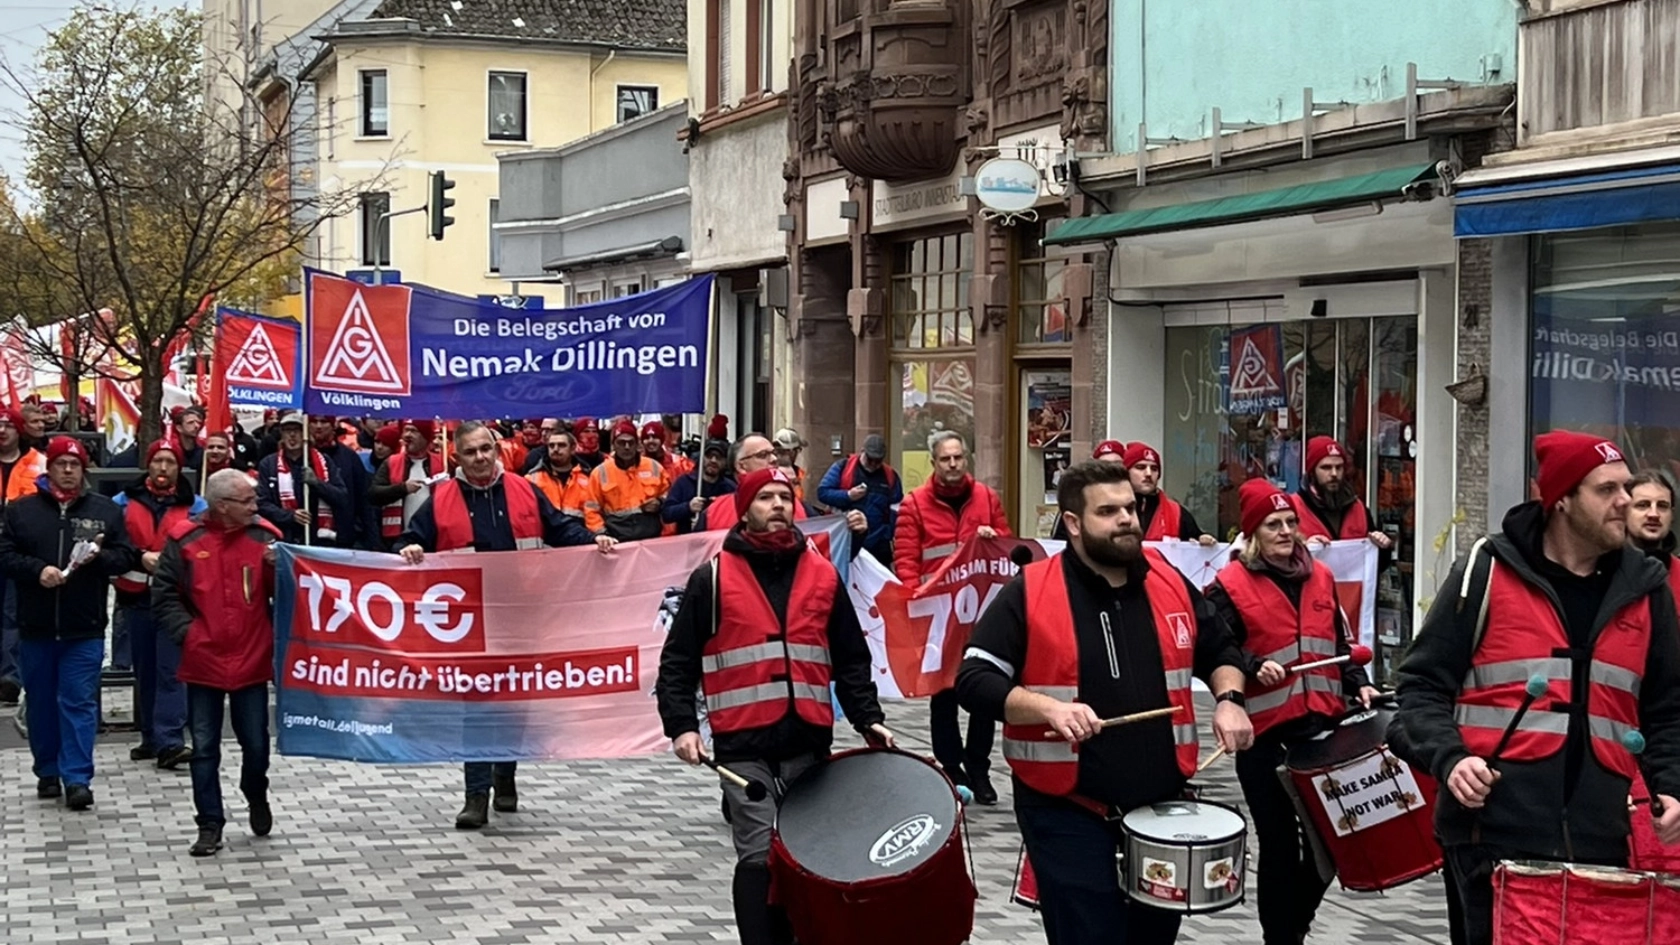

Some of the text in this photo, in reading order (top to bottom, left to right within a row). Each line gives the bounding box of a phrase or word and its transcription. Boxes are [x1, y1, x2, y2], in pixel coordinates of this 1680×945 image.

[454, 310, 666, 341] Die Belegschaft von
[422, 343, 698, 378] Nemak Dillingen
[320, 391, 401, 410] Völklingen
[299, 570, 475, 643] 170 €
[292, 655, 634, 693] sind nicht übertrieben!
[1346, 799, 1372, 818] NOT
[884, 820, 924, 858] RMV
